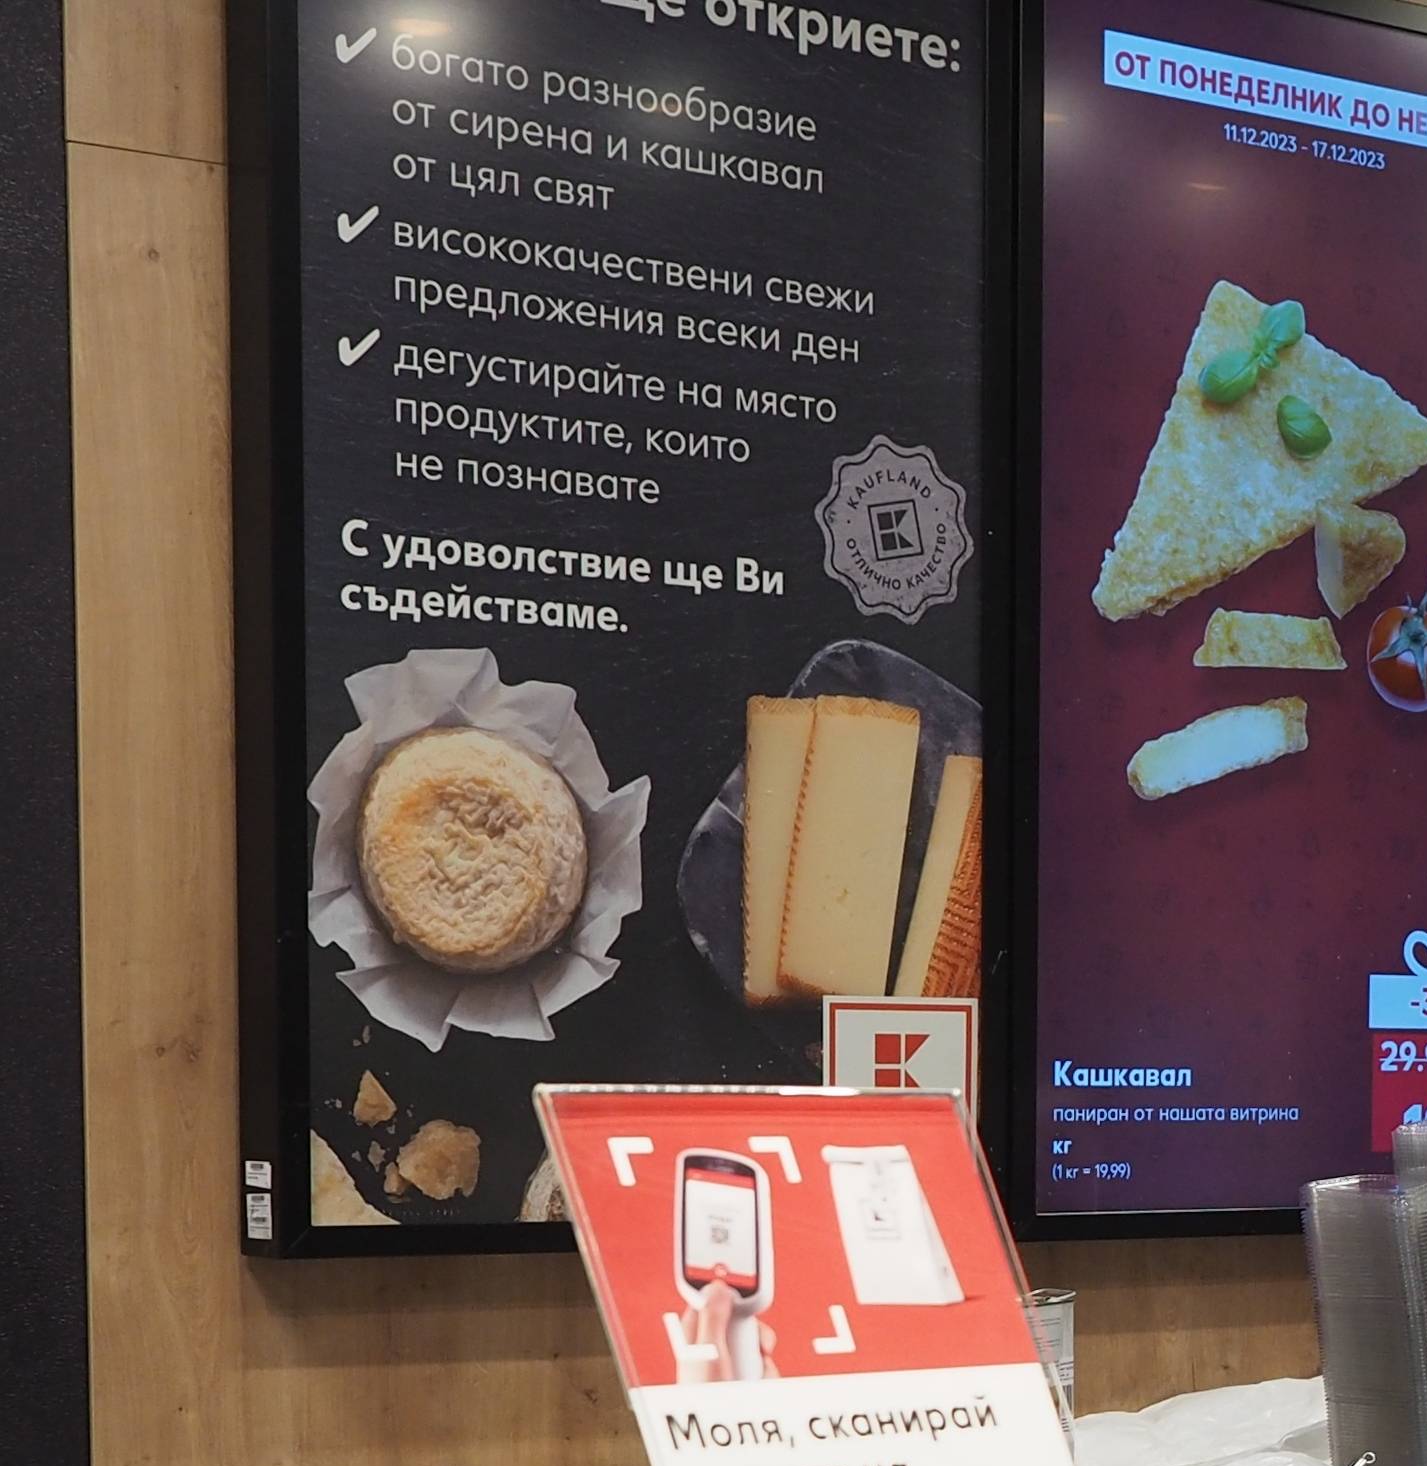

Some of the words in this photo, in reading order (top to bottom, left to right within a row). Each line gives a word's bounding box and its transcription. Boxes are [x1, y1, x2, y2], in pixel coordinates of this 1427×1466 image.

[706, 0, 959, 72] откриете:
[391, 35, 529, 90] богато
[544, 71, 816, 148] разнообразие
[1116, 52, 1151, 80] ОТ
[1161, 60, 1342, 118] ПОНЕДЕЛНИК
[1350, 99, 1389, 129] ДО
[393, 100, 435, 127] от
[450, 109, 591, 154] сирена
[608, 135, 626, 160] и
[642, 141, 822, 193] кашкавал
[1224, 124, 1297, 152] 11.12.2023
[1312, 141, 1385, 169] 17.12.2023
[394, 154, 436, 182] от
[451, 162, 519, 197] цял
[534, 177, 614, 210] свят
[395, 222, 751, 304] висококачествени
[766, 278, 873, 314] свежи
[395, 268, 663, 335] предложения
[678, 316, 779, 351] всеки
[792, 333, 858, 364] ден
[394, 345, 664, 400] дегустирайте
[679, 381, 721, 408] на
[736, 388, 836, 422] място
[396, 398, 632, 454] продуктите,
[647, 428, 749, 462] които
[397, 452, 443, 480] не
[459, 459, 659, 503] познавате
[847, 469, 931, 510] KAUFLAND
[342, 520, 368, 556] С
[383, 534, 650, 592] удоволствие
[664, 561, 722, 594] ще
[737, 558, 783, 594] Ви
[846, 538, 901, 590] ОТЛИЧНО
[906, 523, 946, 589] КАЧЕСТВО
[341, 584, 627, 632] съдействаме.
[1055, 1061, 1191, 1086] Кашкавал
[1053, 1107, 1129, 1125] паниран
[1135, 1108, 1154, 1122] от
[1159, 1106, 1226, 1122] нашата
[1230, 1106, 1299, 1124] витрина
[1052, 1164, 1063, 1181] (1
[1066, 1168, 1079, 1179] кг
[1094, 1162, 1131, 1180] 19,99)
[1053, 1140, 1072, 1154] кг
[666, 1407, 795, 1451] Моля,
[807, 1393, 998, 1443] сканирай
